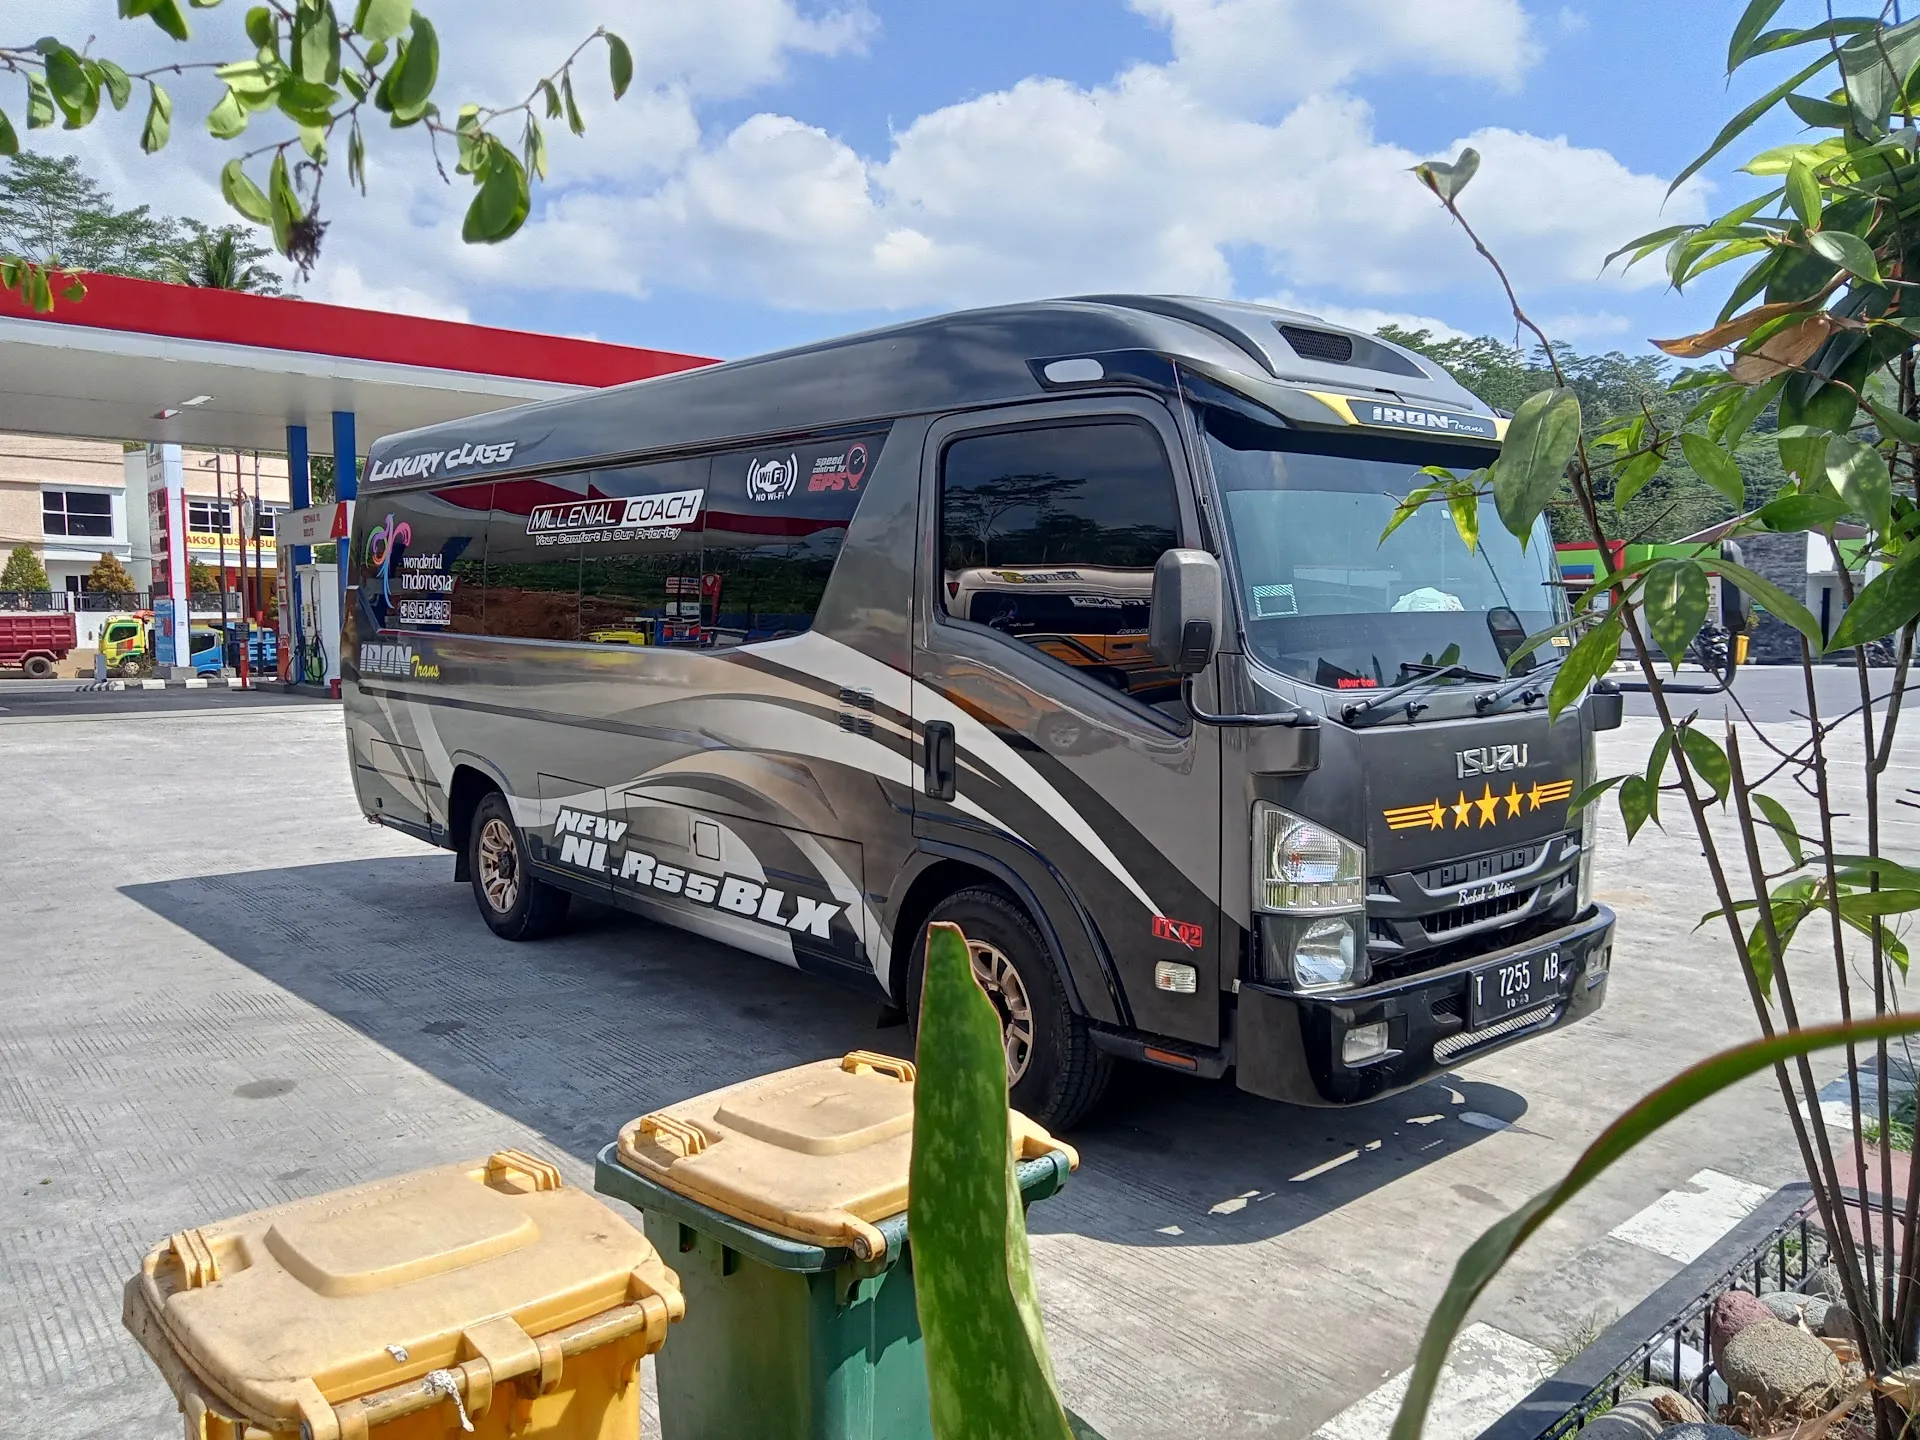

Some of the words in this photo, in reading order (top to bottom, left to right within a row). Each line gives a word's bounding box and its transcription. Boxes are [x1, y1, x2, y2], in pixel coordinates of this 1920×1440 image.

[1373, 406, 1448, 429] IRON
[1448, 419, 1485, 433] Trans
[369, 451, 445, 481] LUXURY
[445, 442, 516, 469] CLASS
[812, 465, 836, 474] control
[837, 464, 847, 473] by
[815, 454, 844, 467] speed
[808, 473, 847, 492] GPS
[755, 493, 766, 502] NO
[767, 491, 785, 501] Wi-Fi
[531, 502, 616, 530] MILLENIAL
[626, 495, 697, 522] COACH
[186, 535, 215, 545] AKSO
[535, 534, 557, 546] Your
[557, 532, 600, 545] Comfort
[613, 529, 634, 541] Our
[635, 526, 681, 541] Priority
[403, 553, 443, 569] wonderful
[402, 569, 453, 592] indonesia
[360, 644, 412, 675] IRON
[411, 655, 440, 679] Trans
[1455, 743, 1528, 779] ISUZU
[554, 809, 628, 842] NEW
[1475, 975, 1484, 1006] T
[1499, 961, 1531, 997] 7255
[1543, 952, 1559, 983] AB
